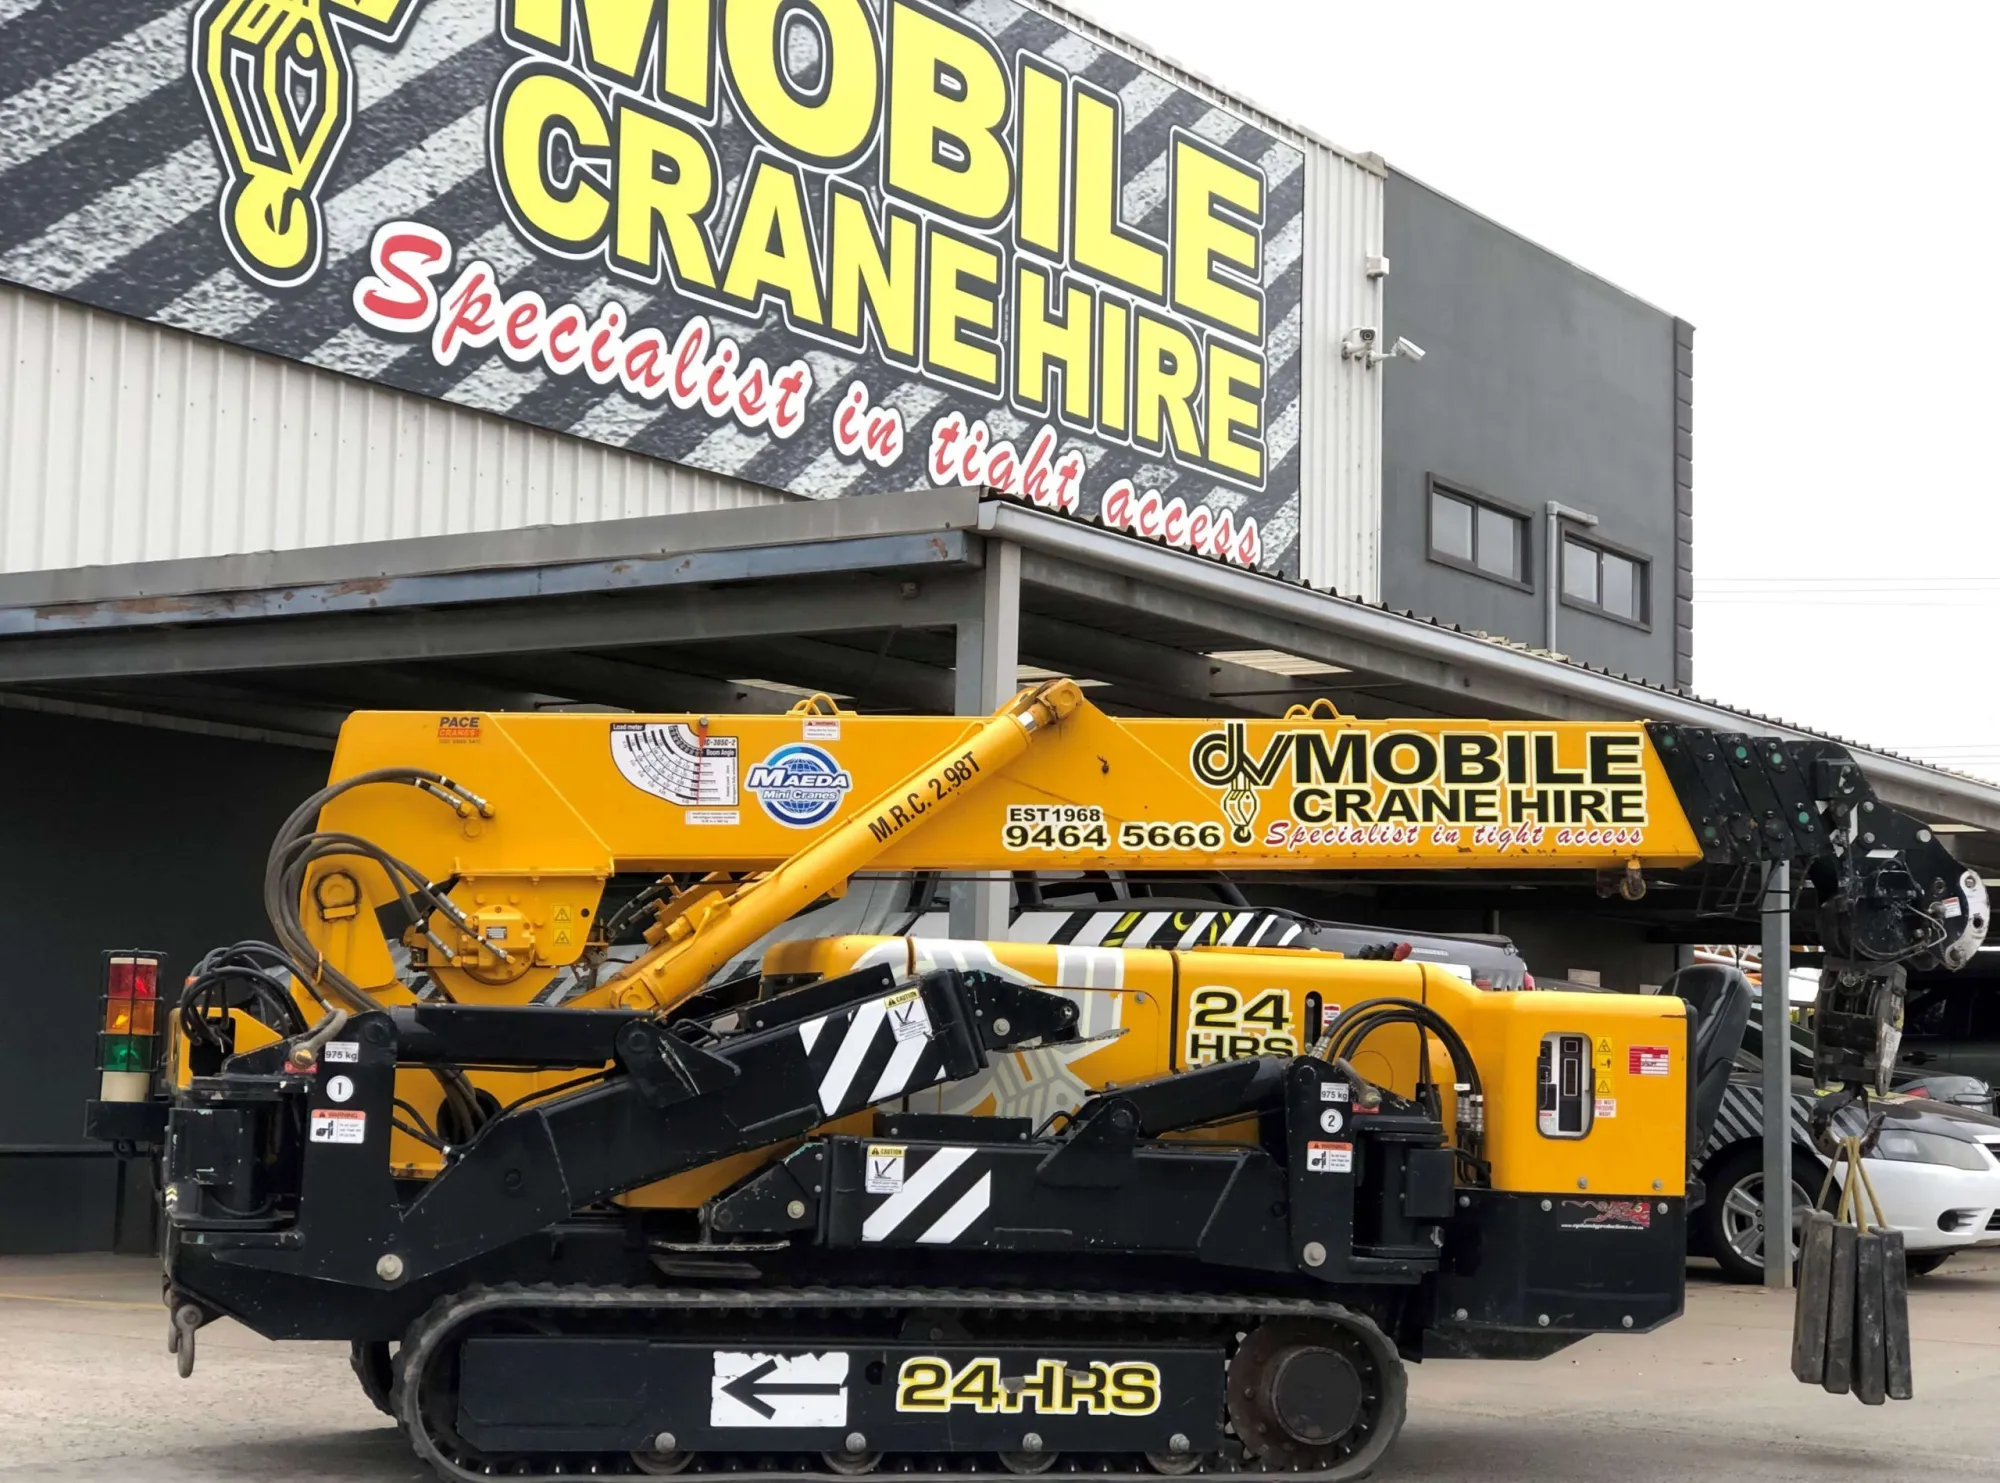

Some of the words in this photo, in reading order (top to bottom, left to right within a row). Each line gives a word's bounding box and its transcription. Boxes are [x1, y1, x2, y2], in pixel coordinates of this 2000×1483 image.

[502, 74, 999, 386] CRANE
[1016, 263, 1262, 480] HIRE
[362, 233, 804, 428] Specialist
[837, 389, 901, 458] in
[934, 419, 1080, 507] tight
[1105, 487, 1258, 564] access
[439, 716, 480, 728] PACE
[613, 723, 628, 731] Load
[629, 723, 644, 731] meter
[706, 748, 720, 756] Boom
[720, 748, 735, 757] Angle
[1294, 731, 1643, 786] MOBILE
[927, 750, 981, 801] 2.98T
[762, 789, 791, 800] Mini
[792, 789, 838, 801] Cranes
[1292, 787, 1500, 824] CRANE
[1510, 788, 1646, 824] HIRE
[1005, 824, 1108, 848] 9464
[1121, 824, 1222, 848] 5666
[1265, 821, 1420, 850] Specialist
[1431, 824, 1460, 844] in
[1473, 820, 1545, 850] tight
[1556, 827, 1643, 844] access
[1194, 990, 1291, 1031] 24
[325, 1050, 343, 1060] 975
[345, 1050, 358, 1062] kg
[1190, 1033, 1294, 1063] HRS
[336, 1082, 343, 1096] 1
[1320, 1090, 1336, 1099] 975
[1337, 1090, 1348, 1101] kg
[1327, 1114, 1336, 1128] 2
